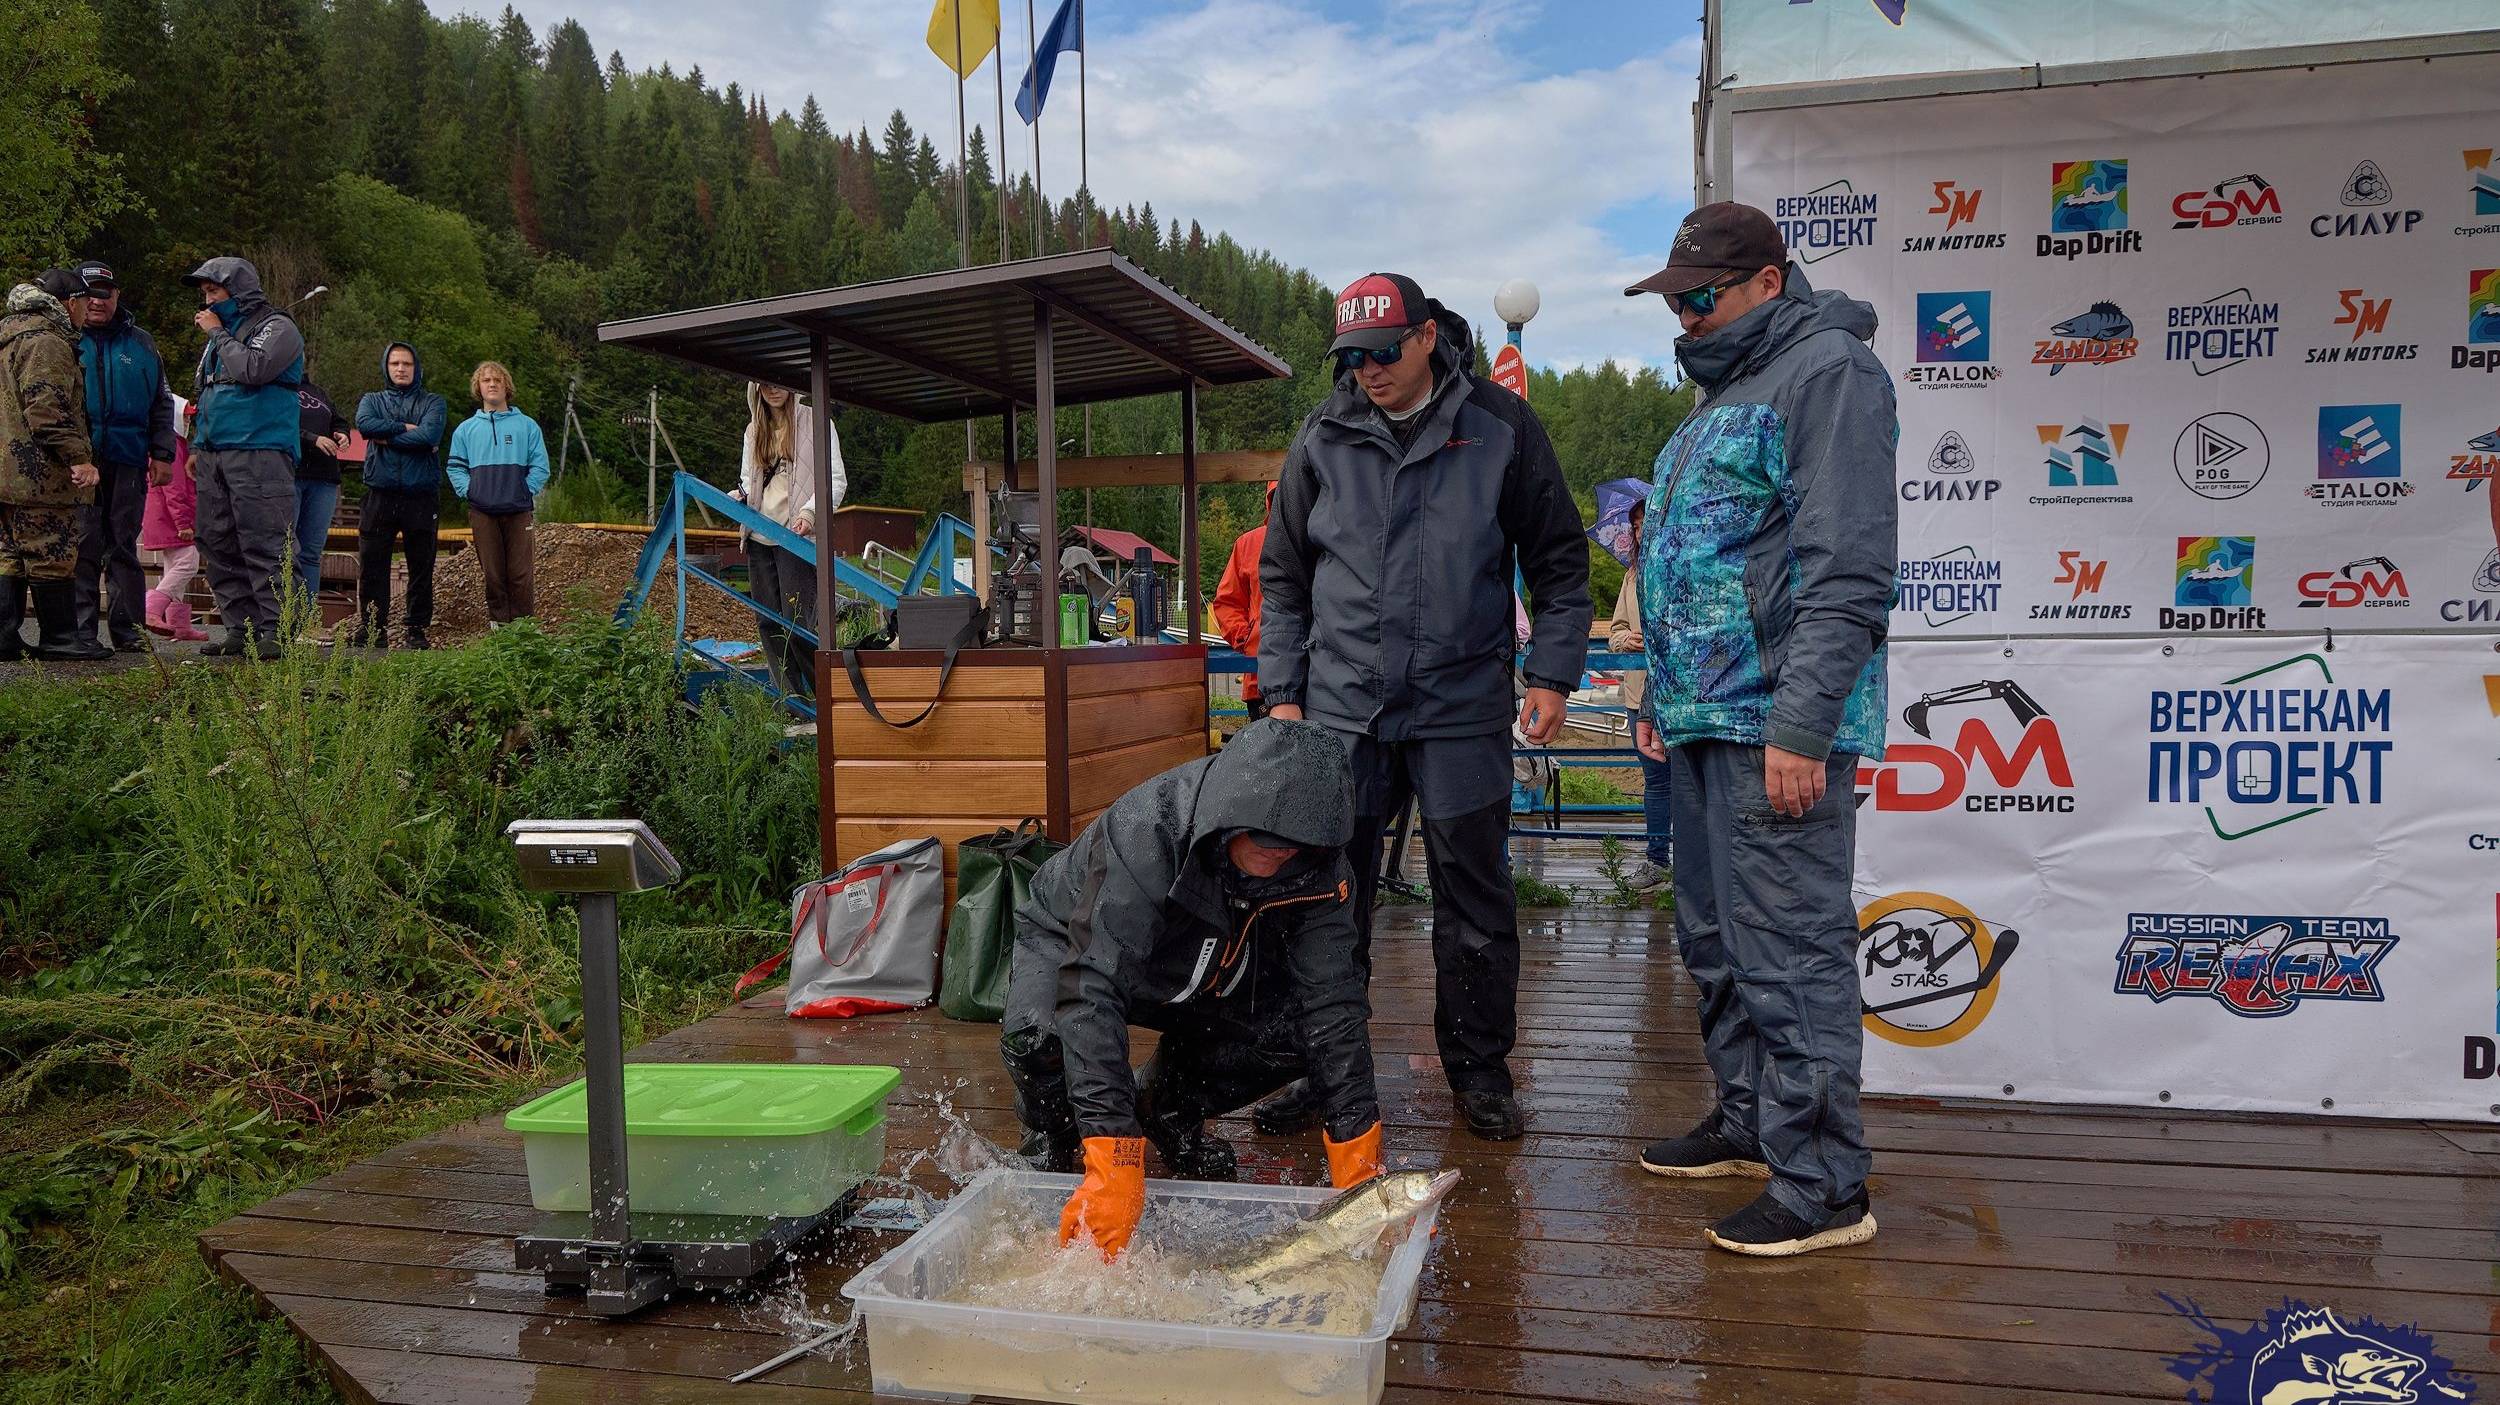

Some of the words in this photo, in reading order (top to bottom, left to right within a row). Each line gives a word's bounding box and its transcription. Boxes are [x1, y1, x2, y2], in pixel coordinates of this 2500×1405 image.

[1776, 194, 1877, 217] ВЕРХНЕКАМ
[2237, 216, 2282, 227] СЕРВИС
[2310, 209, 2425, 238] СИЛУР
[1776, 217, 1877, 249] ПРОЕКТ
[1902, 237, 1934, 252] SAN
[1938, 233, 2007, 251] MOTORS
[2037, 234, 2083, 261] Dap
[2087, 230, 2142, 255] Drift
[2168, 303, 2279, 327] ВЕРХНЕКАМ
[2031, 338, 2139, 363] ZANDER
[2166, 327, 2279, 360] ПРОЕКТ
[2305, 348, 2339, 363] SAN
[2344, 344, 2419, 362] MOTORS
[2451, 345, 2500, 373] Dap
[1909, 365, 1998, 382] ETALON
[1918, 382, 1949, 391] СТУДИЯ
[1950, 382, 1988, 390] РЕКЛАМЫ
[2196, 469, 2229, 479] POG
[1900, 479, 2002, 501] СИЛУР
[2029, 495, 2133, 506] СтройПерспектива
[2311, 481, 2410, 499] ETALON
[2321, 500, 2354, 508] СТУДИЯ
[2356, 499, 2398, 507] РЕКЛАМЫ
[1900, 561, 2001, 580] ВЕРХНЕКАМ
[1900, 583, 2002, 612] ПРОЕКТ
[2364, 600, 2410, 608] СЕРВИС
[2029, 605, 2062, 619] SAN
[2065, 605, 2132, 619] MOTORS
[2159, 607, 2206, 631] Dap
[2210, 606, 2266, 629] Drift
[2440, 599, 2500, 622] СИ
[2150, 688, 2391, 733] ВЕРХНЕКАМ
[2148, 740, 2393, 805] ПРОЕКТ
[1965, 795, 2075, 813] СЕРВИС
[2131, 916, 2248, 935] RUSSIAN
[2302, 919, 2385, 938] TEAM
[1891, 973, 1949, 988] STARS
[2464, 1036, 2500, 1079] D
